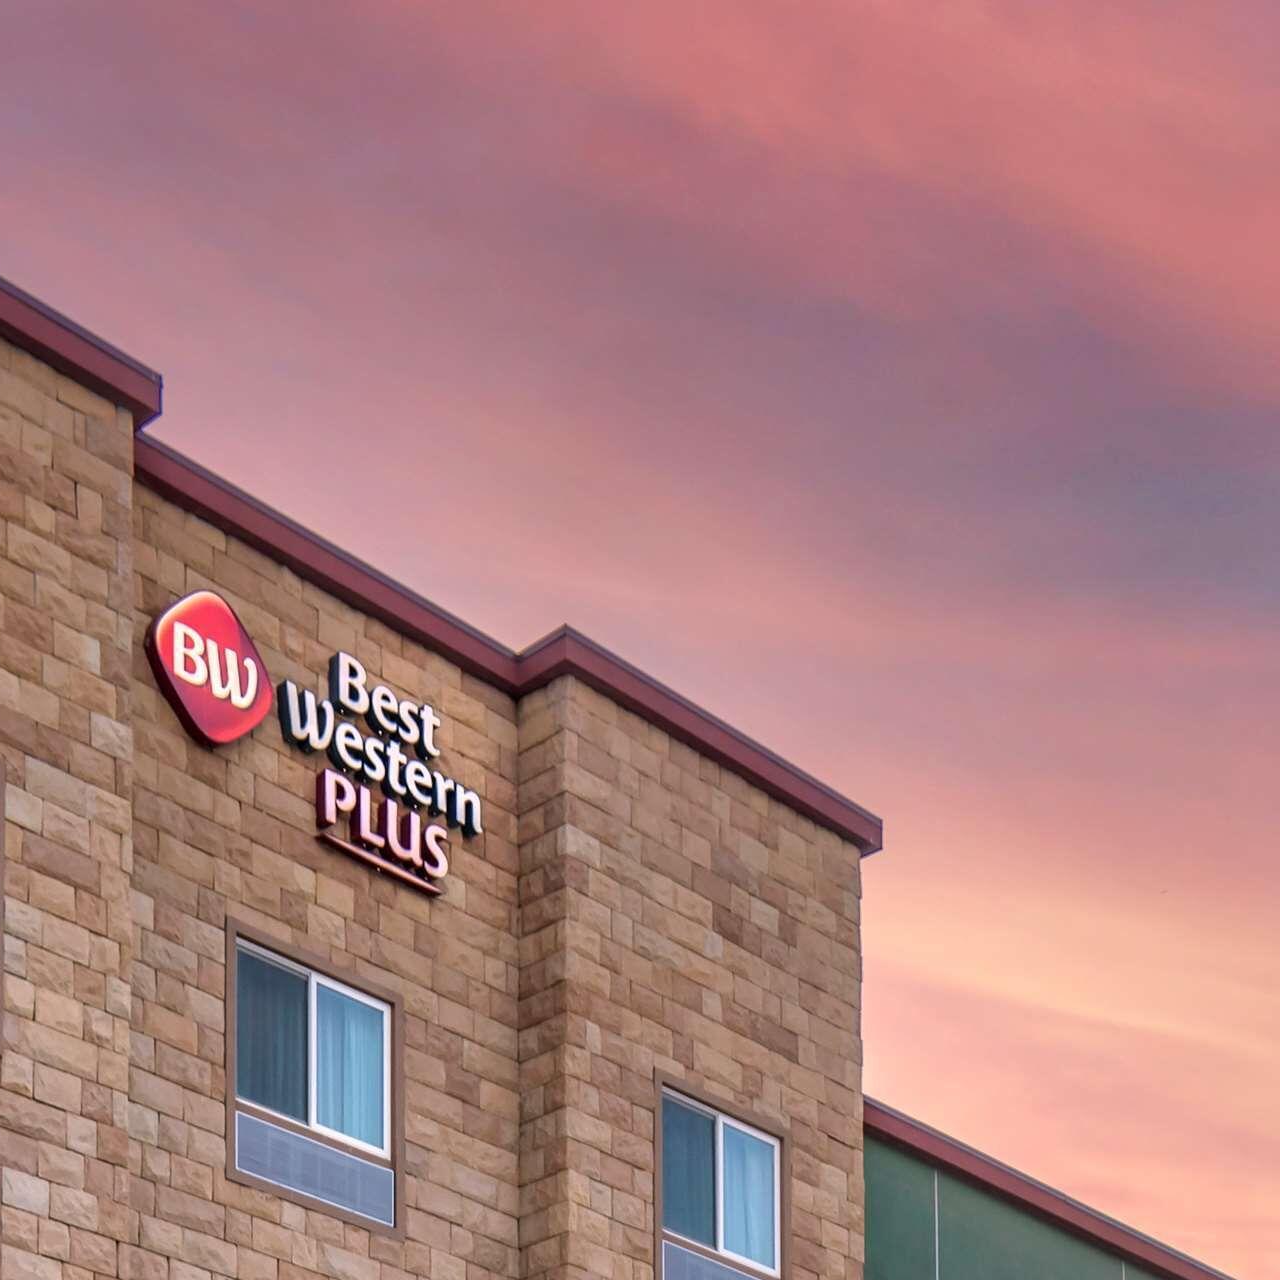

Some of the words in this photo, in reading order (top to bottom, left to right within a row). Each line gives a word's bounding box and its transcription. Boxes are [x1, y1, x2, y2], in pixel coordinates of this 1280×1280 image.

[173, 621, 258, 709] BW
[332, 652, 440, 757] Best
[279, 680, 483, 833] Western
[318, 769, 448, 878] PLUS
